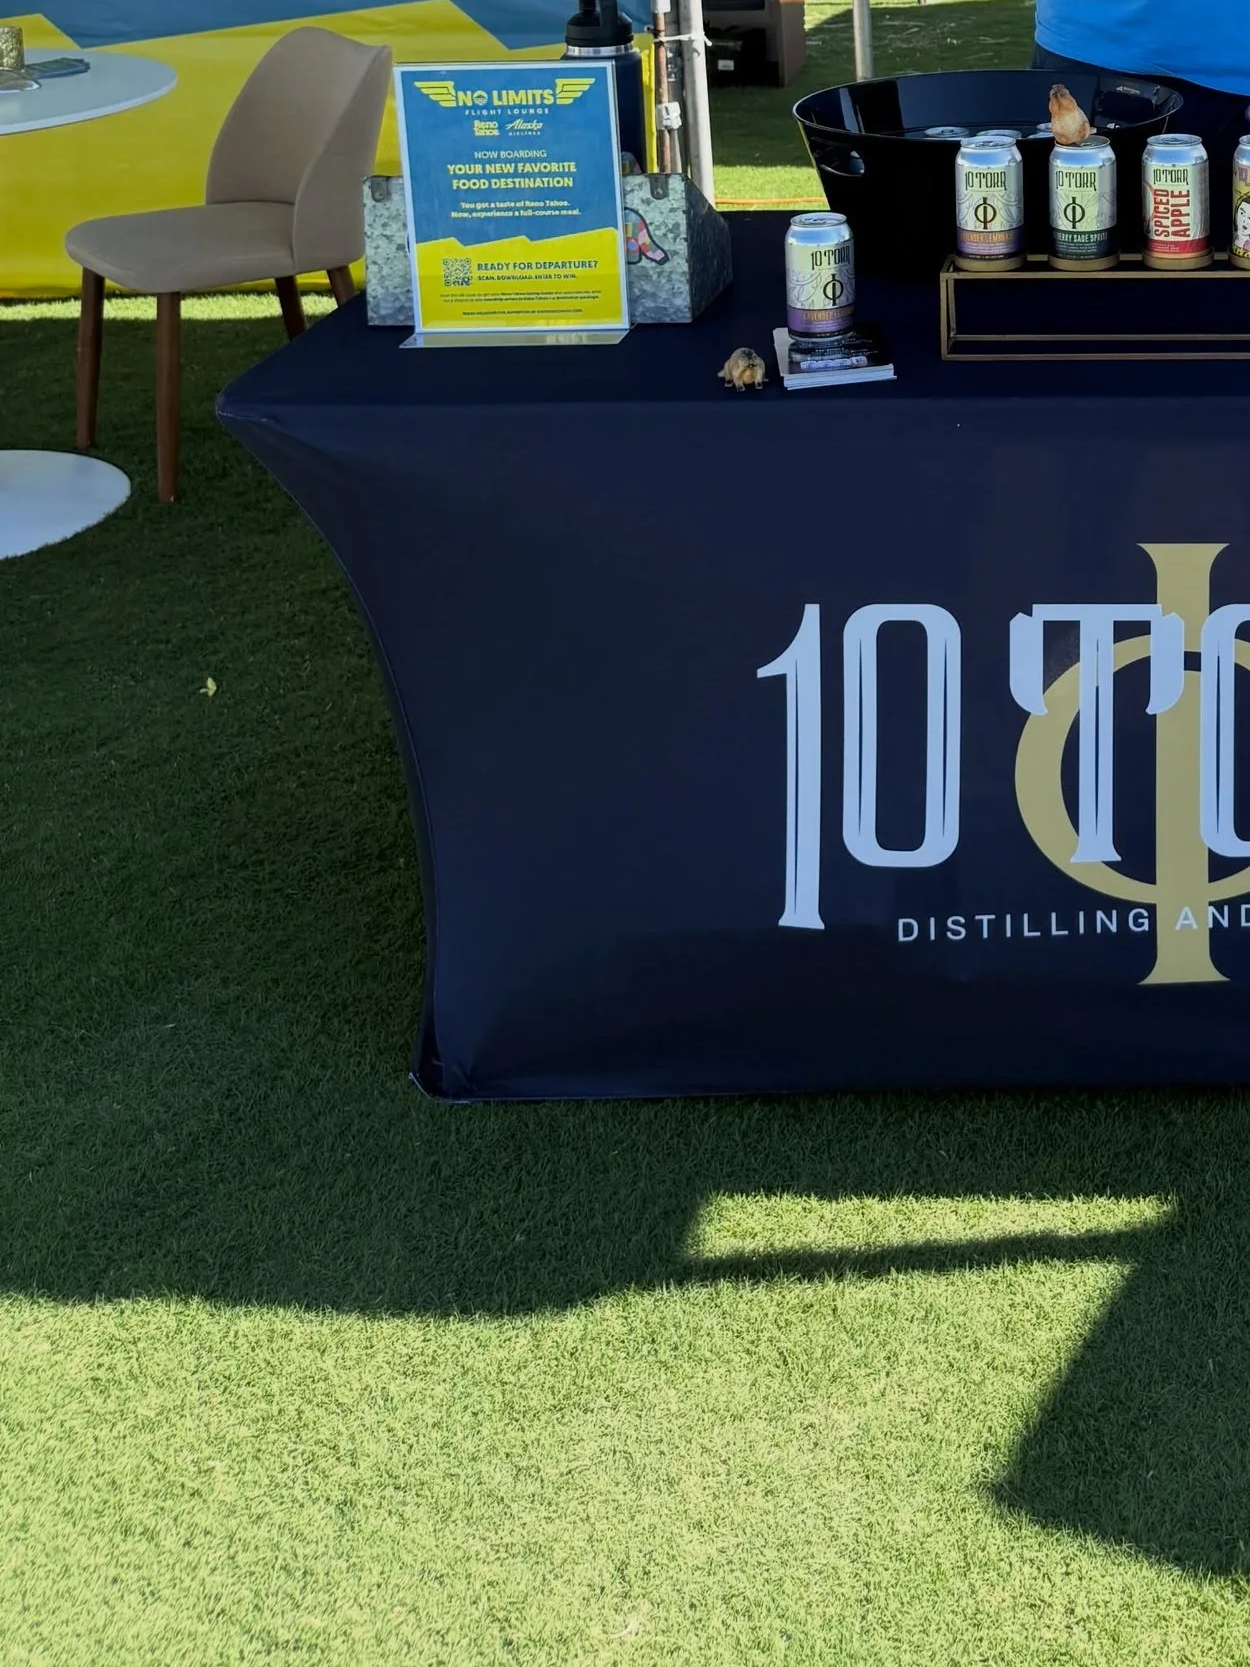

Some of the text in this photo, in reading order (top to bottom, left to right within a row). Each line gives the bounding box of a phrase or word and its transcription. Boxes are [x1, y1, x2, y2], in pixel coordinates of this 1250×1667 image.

[493, 89, 554, 106] LIMITS
[505, 118, 544, 131] Alaska
[474, 150, 547, 159] NOW BOARDING
[447, 162, 577, 175] YOUR NEW FAVORITE
[1153, 168, 1189, 186] 10 TORR
[452, 177, 573, 190] FOOD DESTINATION
[965, 170, 1007, 191] 10 TORR
[1055, 170, 1097, 191] 10 TORR
[476, 202, 489, 210] got
[1154, 188, 1170, 238] SPICED
[1170, 189, 1190, 238] APPLE
[472, 211, 513, 219] experience
[1055, 233, 1072, 242] ERRY
[1073, 234, 1090, 242] SAGE
[477, 260, 598, 271] READY FOR DEPARTURE?
[811, 250, 822, 270] 10
[756, 602, 962, 931] 10
[897, 908, 1151, 942] DISTILLING
